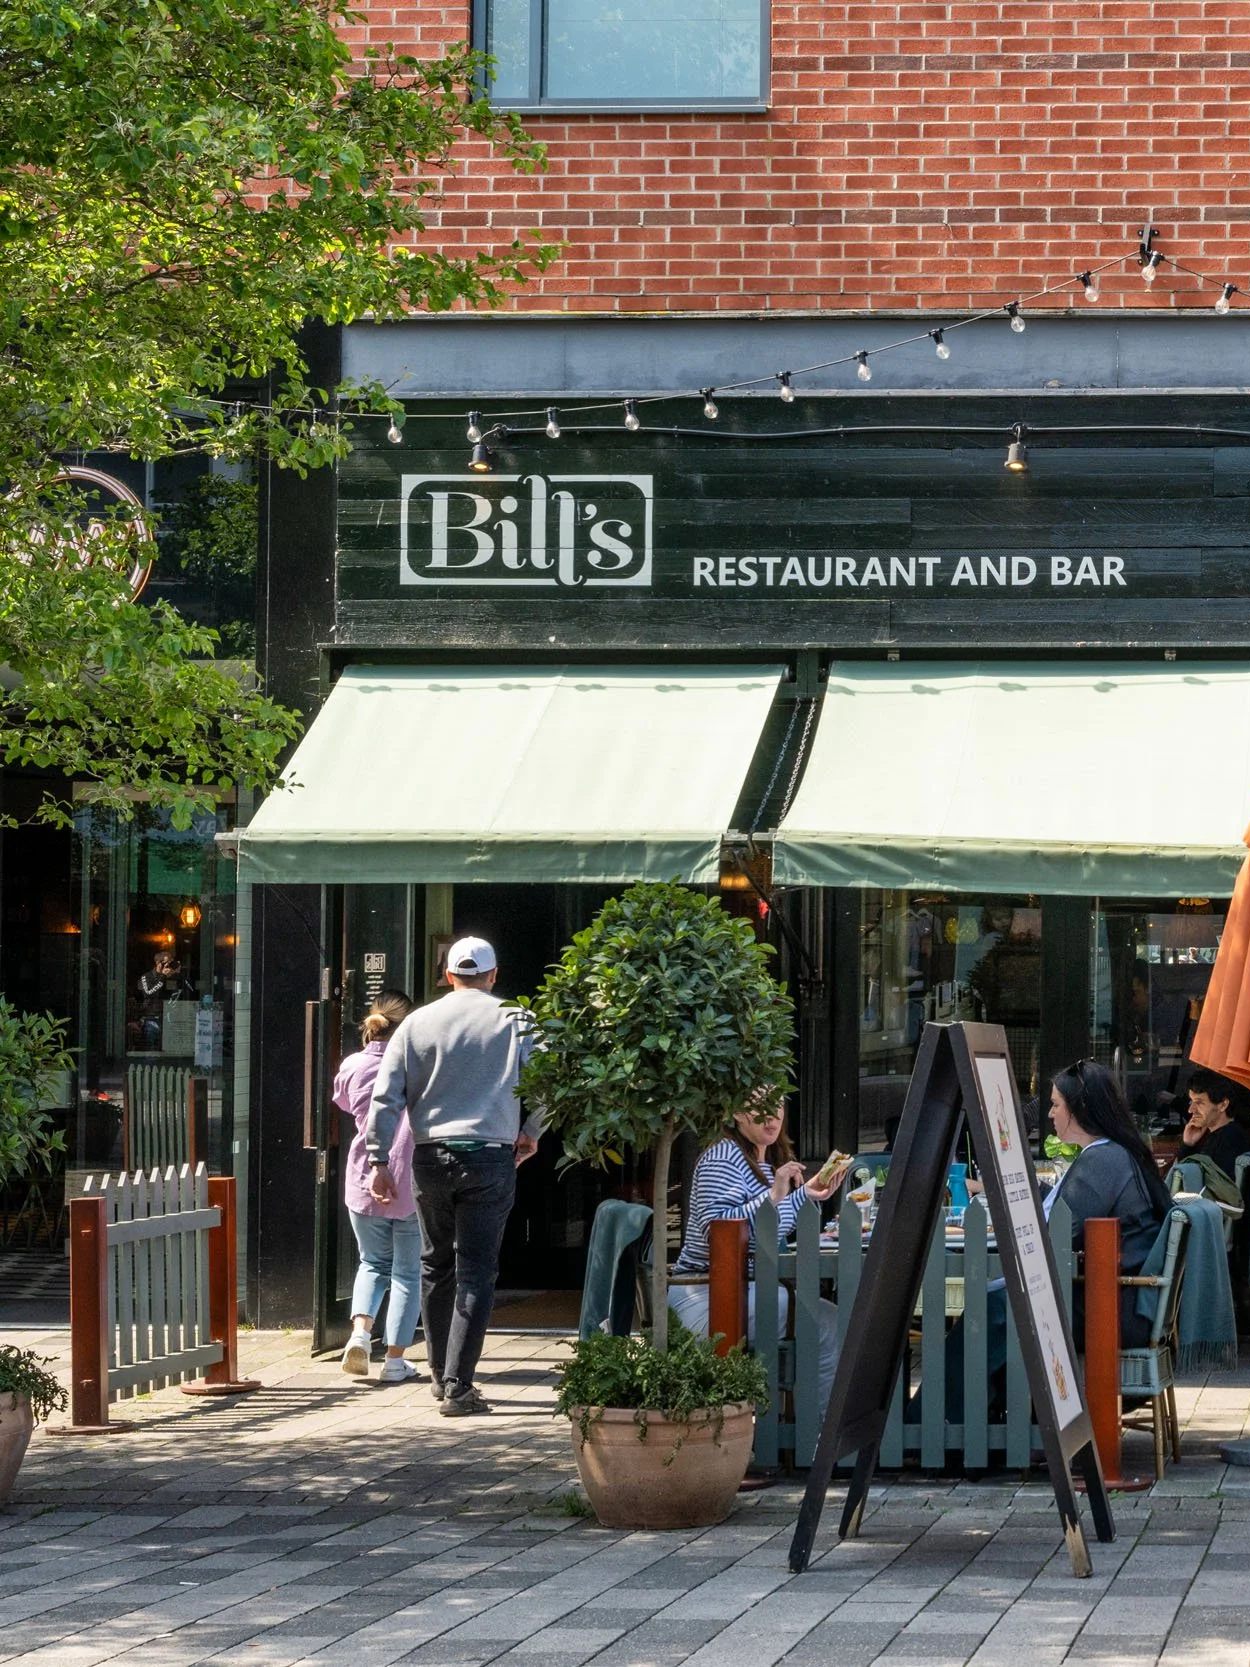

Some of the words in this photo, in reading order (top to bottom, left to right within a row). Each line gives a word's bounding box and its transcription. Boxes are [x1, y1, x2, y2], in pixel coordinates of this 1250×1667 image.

[425, 475, 634, 586] Bill's
[693, 556, 941, 587] RESTAURANT
[950, 556, 1037, 586] AND
[1051, 556, 1127, 586] BAR
